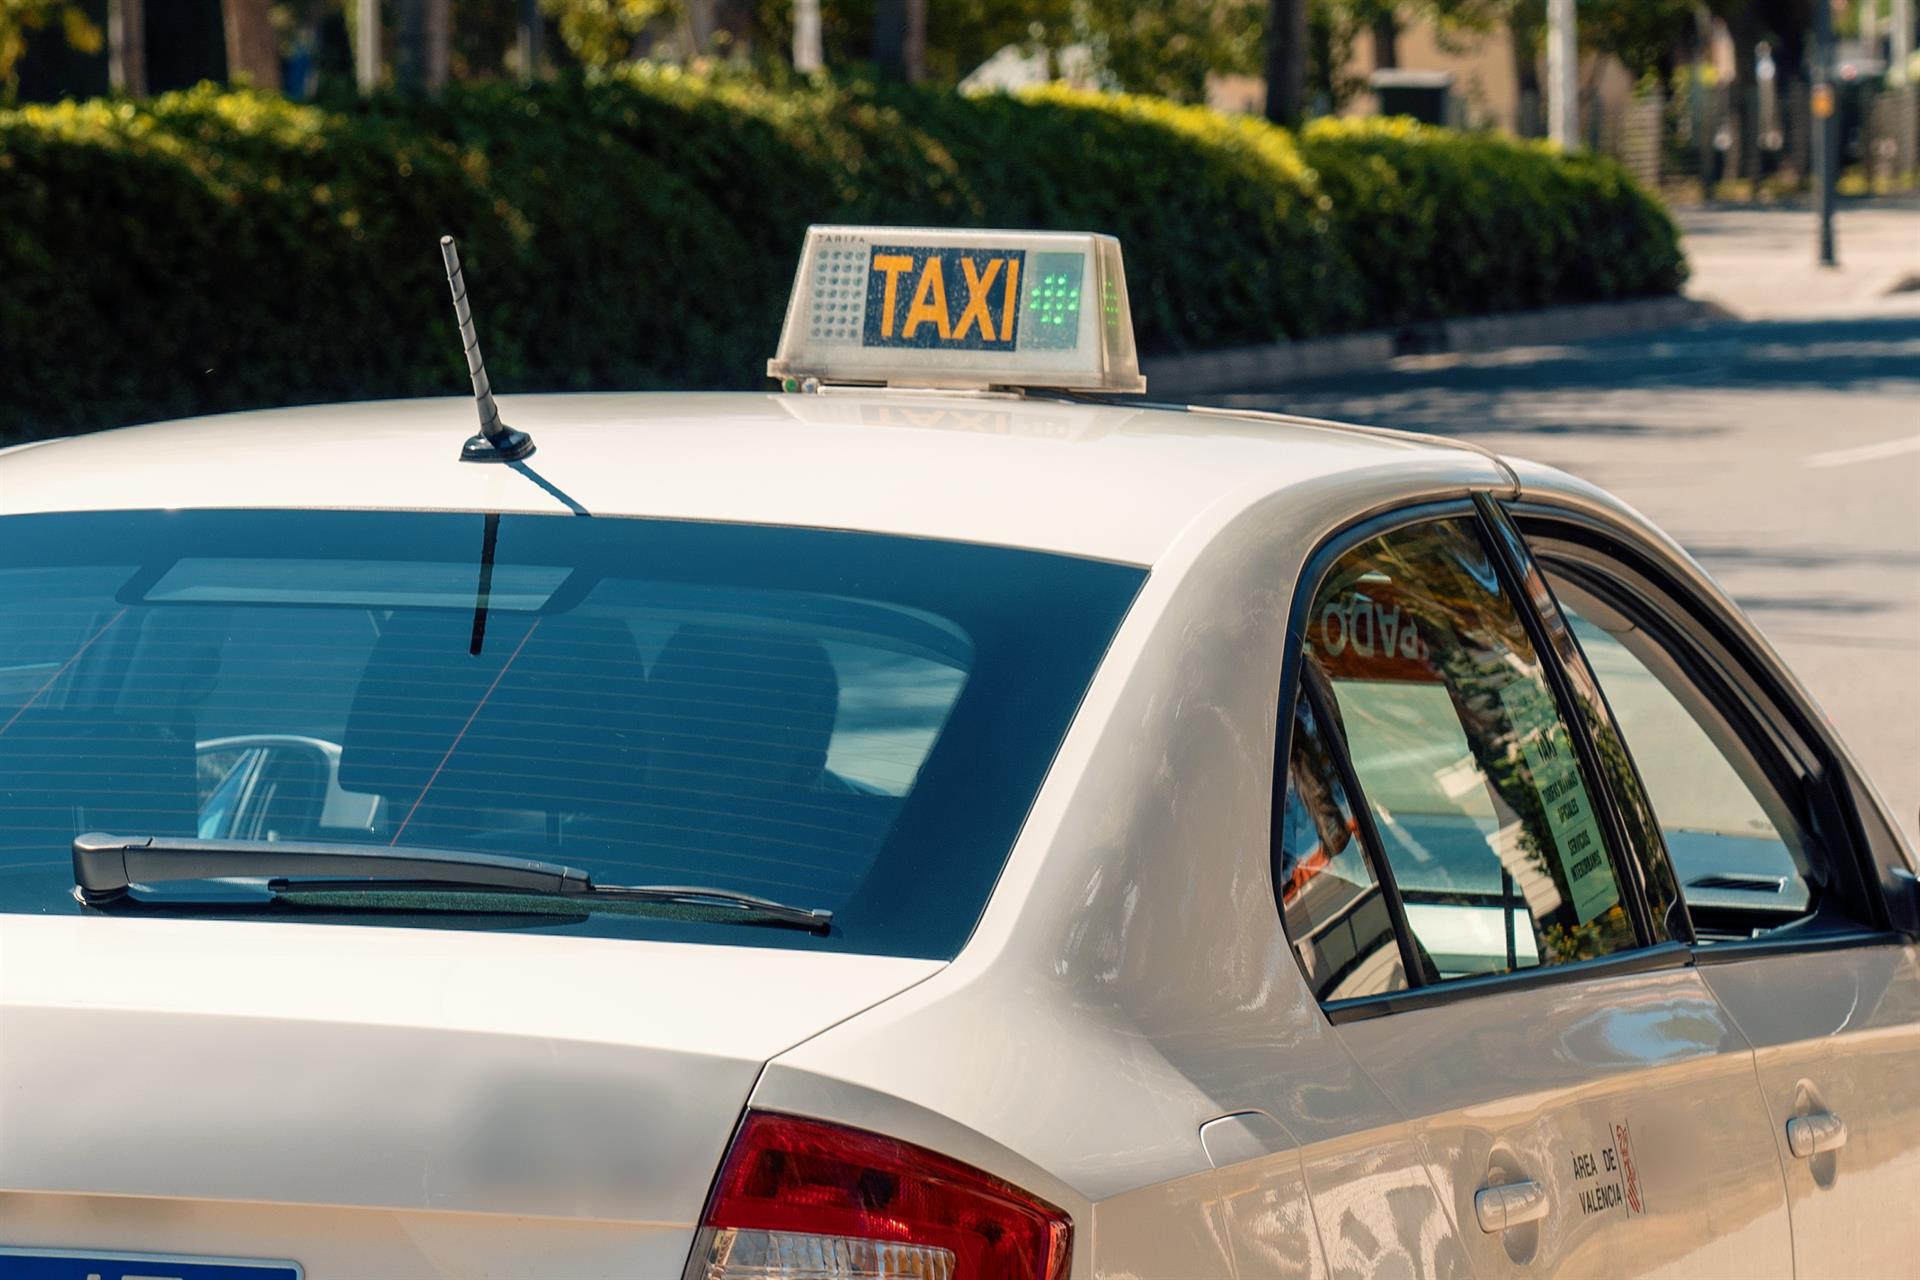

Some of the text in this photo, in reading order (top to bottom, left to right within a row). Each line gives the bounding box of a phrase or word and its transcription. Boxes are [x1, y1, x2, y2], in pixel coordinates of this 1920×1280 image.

[872, 254, 1019, 342] TAXI
[1321, 602, 1429, 661] PADO
[1570, 1148, 1616, 1180] ÀREA DE
[1579, 1181, 1623, 1215] VALÈNCIA
